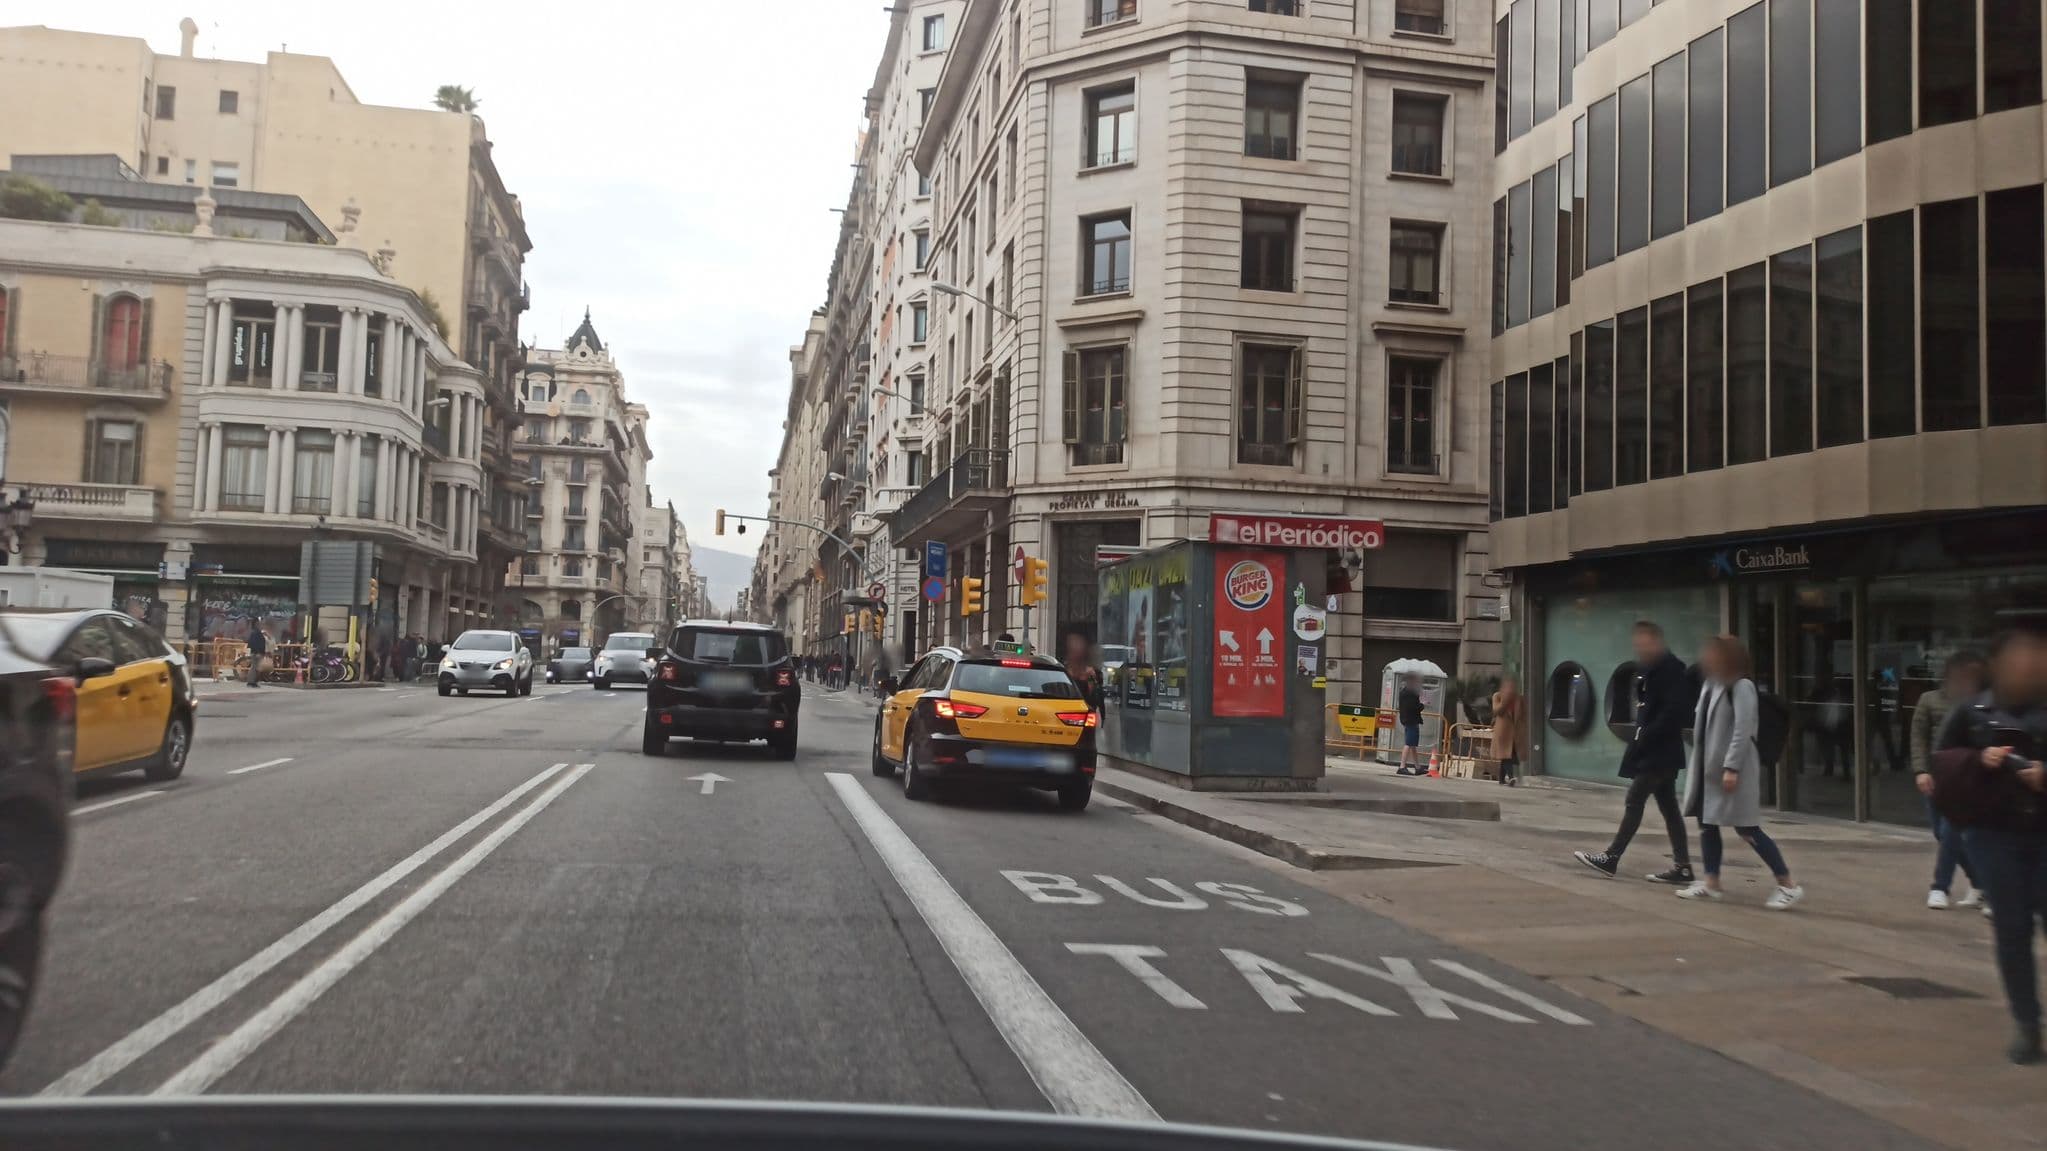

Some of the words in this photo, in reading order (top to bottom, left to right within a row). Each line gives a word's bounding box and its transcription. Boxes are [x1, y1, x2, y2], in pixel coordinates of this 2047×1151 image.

[1239, 521, 1261, 543] el
[1264, 521, 1380, 548] Periódico
[1735, 544, 1810, 569] CaixaBank
[1231, 569, 1266, 587] BURGER
[1232, 578, 1268, 598] KING
[999, 870, 1310, 917] BUS
[1063, 942, 1595, 1026] TAXI
